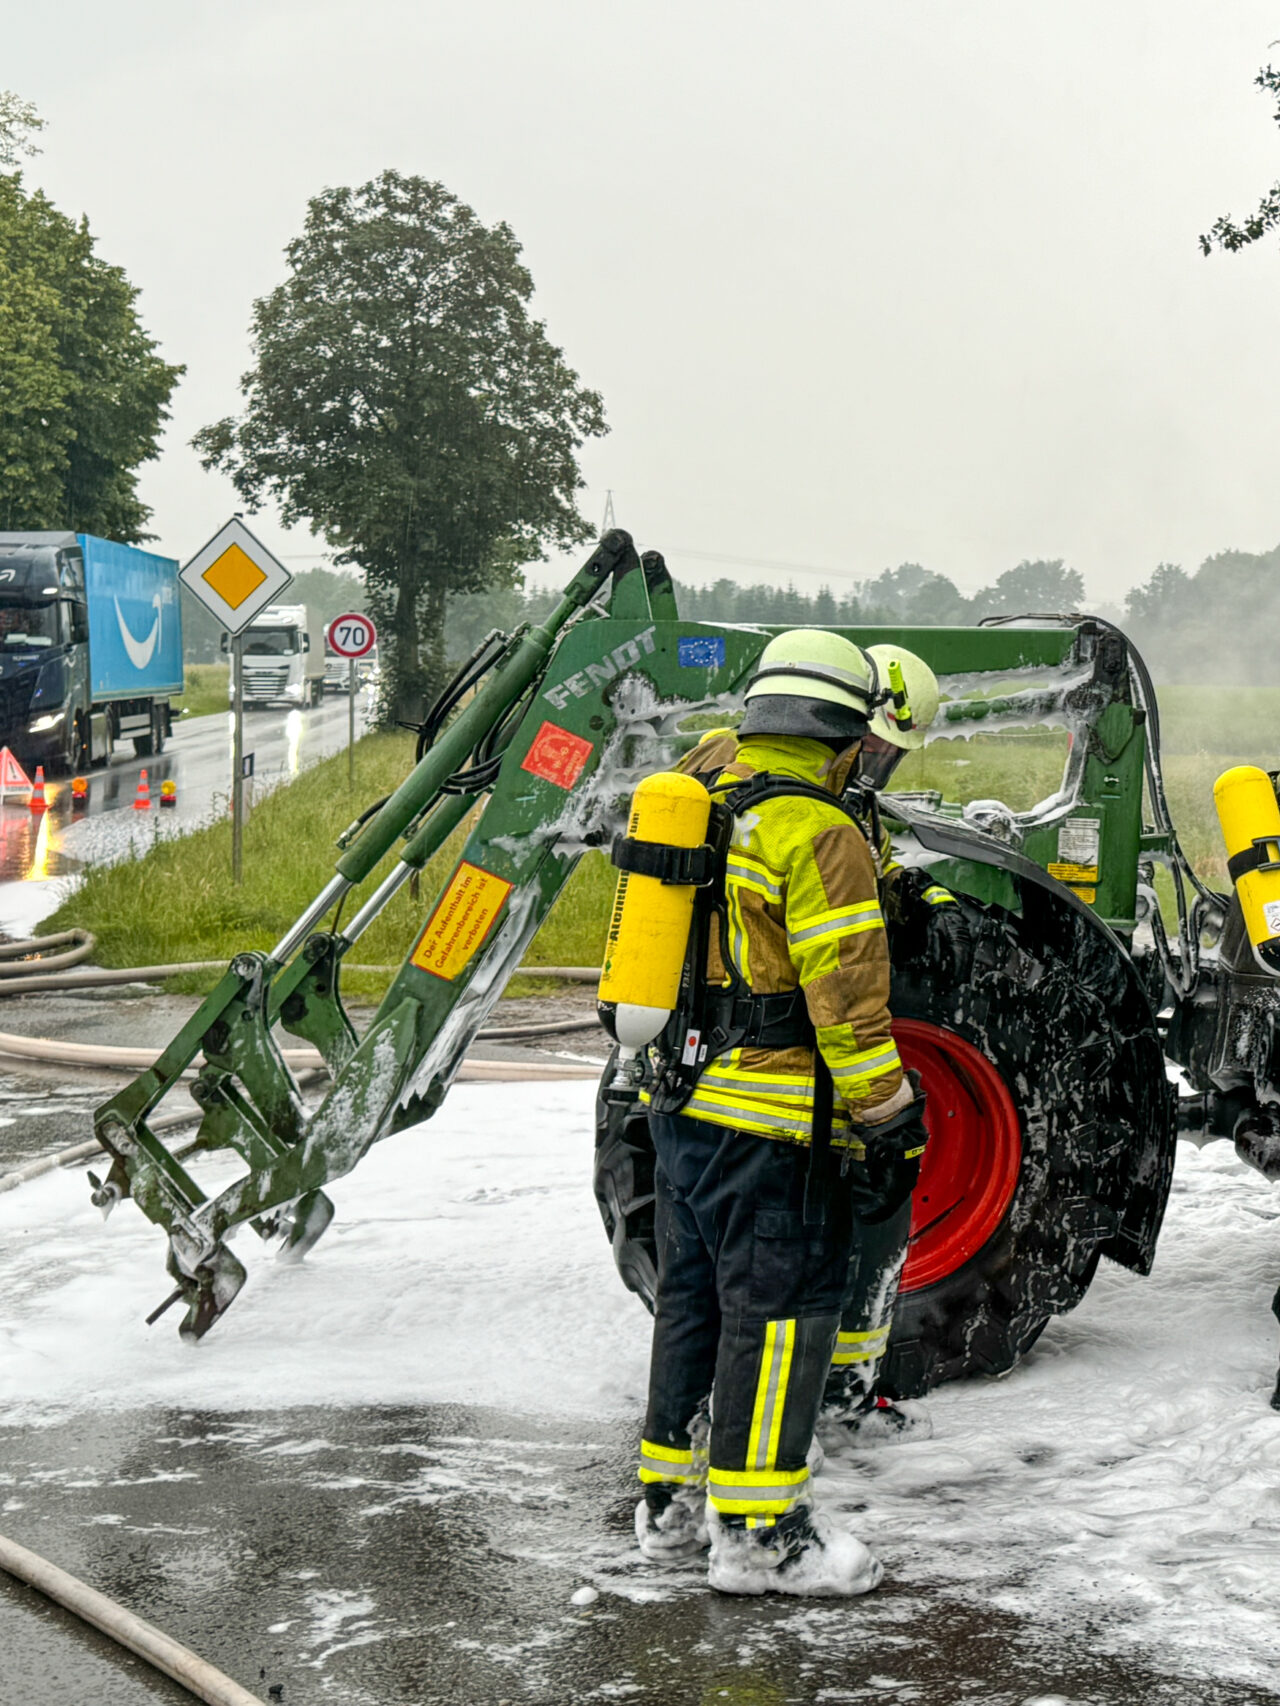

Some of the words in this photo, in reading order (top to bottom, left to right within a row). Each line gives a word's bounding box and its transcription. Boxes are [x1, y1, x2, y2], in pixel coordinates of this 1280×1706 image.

[339, 626, 365, 647] 70
[542, 625, 657, 711] FENDT
[423, 939, 439, 959] Der
[434, 889, 467, 939] Aufenthalt
[461, 876, 473, 889] im
[434, 892, 481, 969] Gefahrenbereich
[475, 878, 489, 891] ist
[462, 908, 489, 951] verboten
